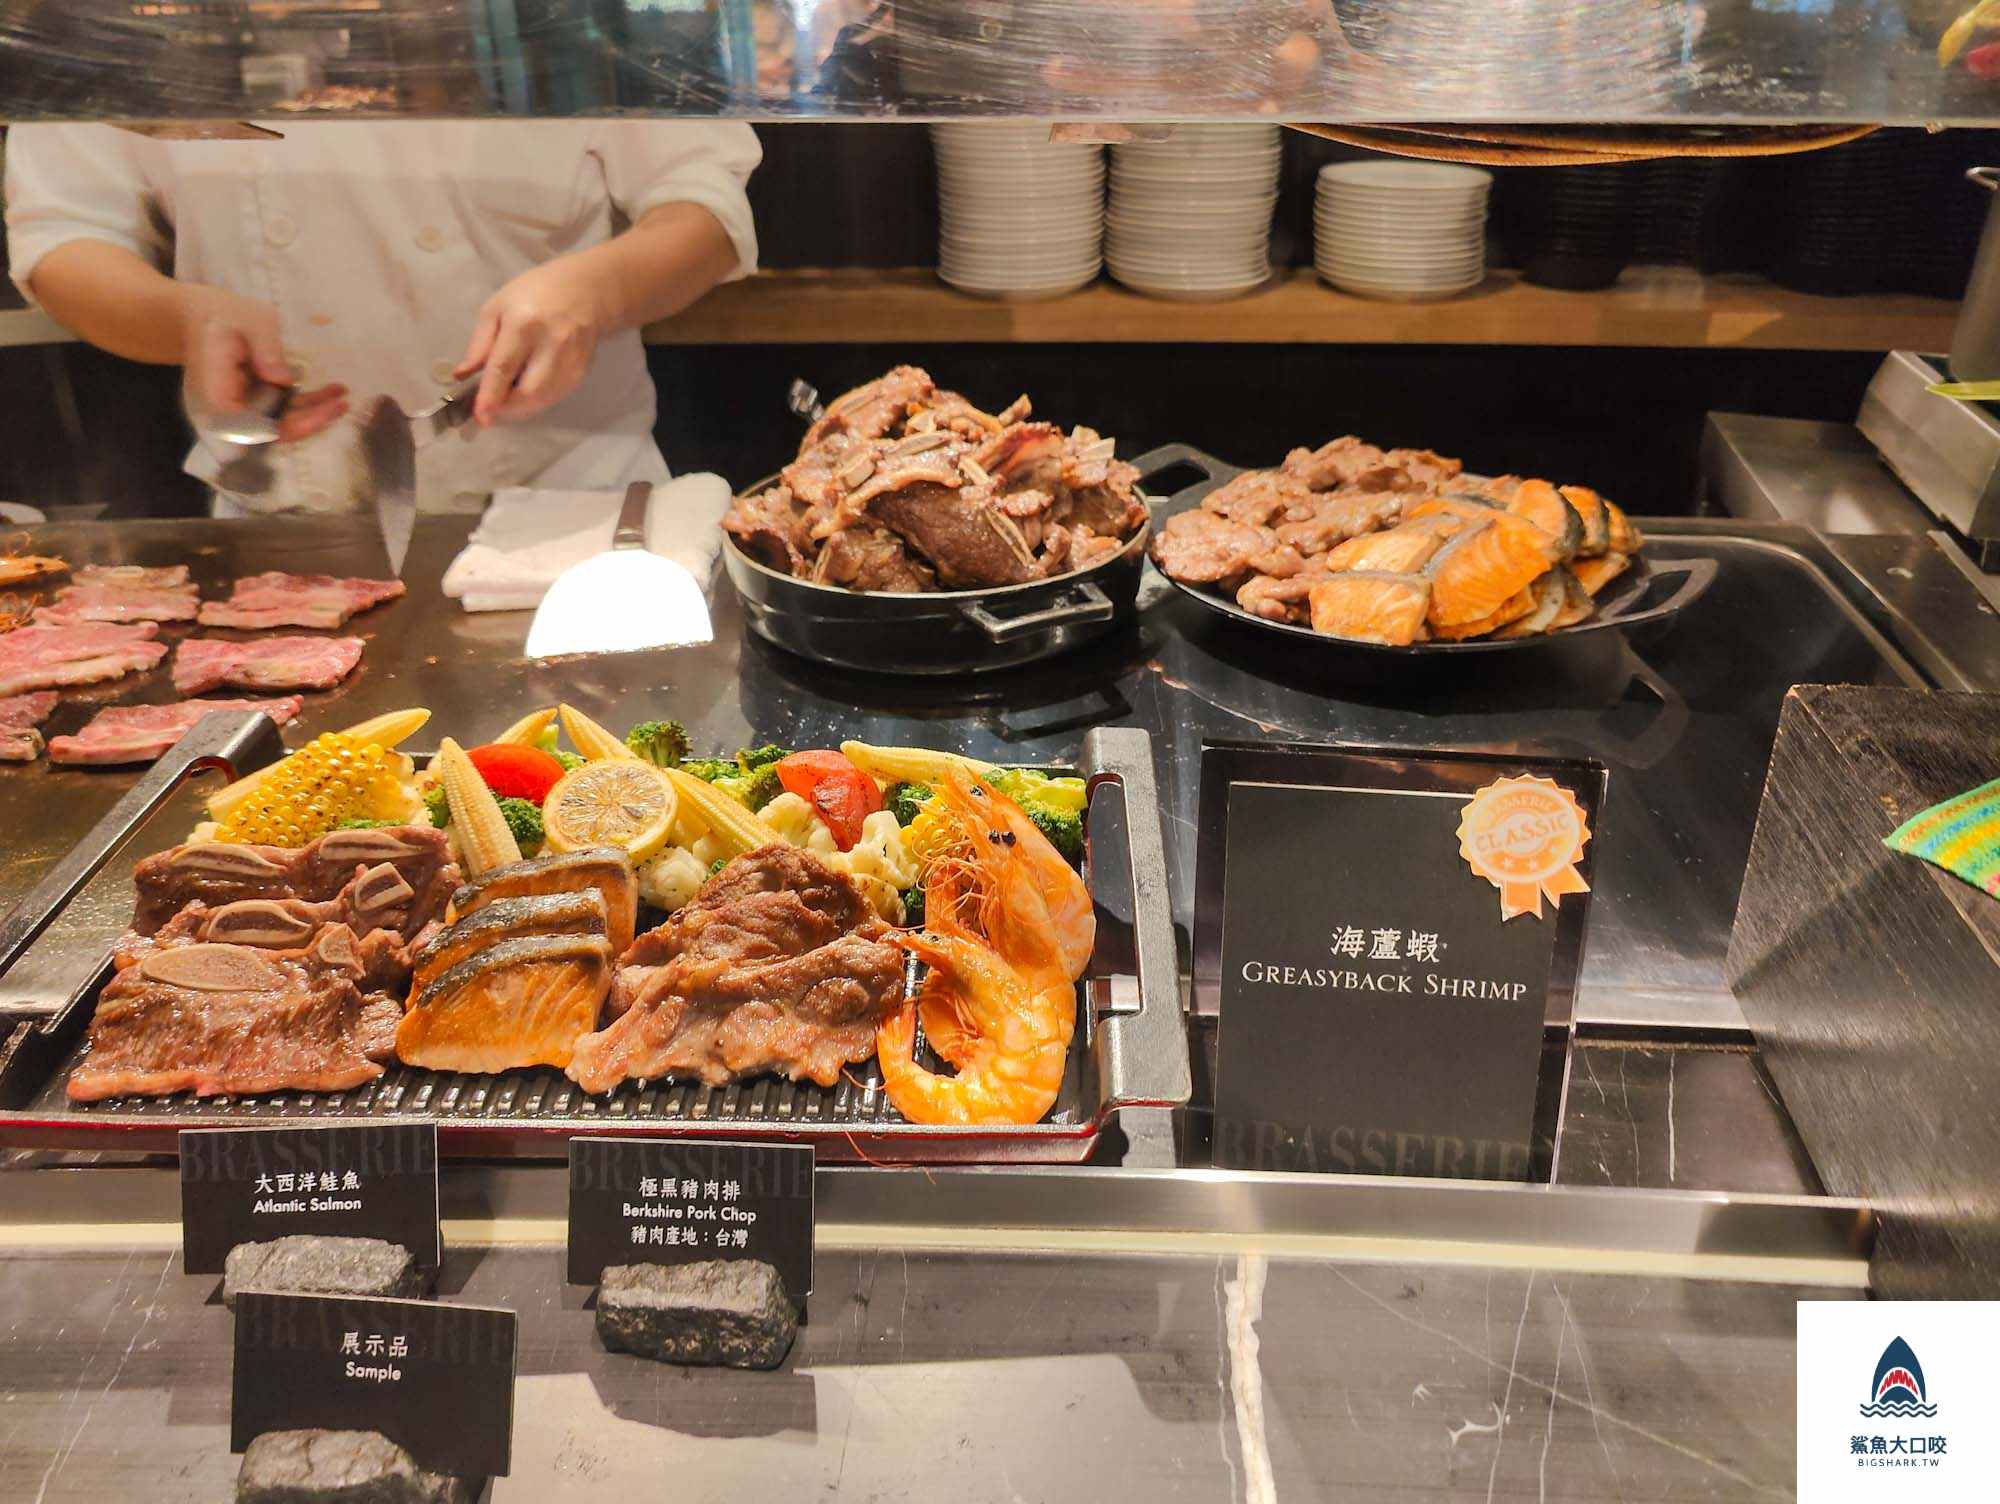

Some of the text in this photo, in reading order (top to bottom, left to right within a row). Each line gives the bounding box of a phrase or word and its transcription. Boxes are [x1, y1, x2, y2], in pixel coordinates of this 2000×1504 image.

[1475, 812, 1570, 852] CLASSIC
[1330, 925, 1440, 963] 海蘆蝦
[1242, 962, 1528, 1001] GREASYBACK SHRIMP
[254, 1170, 362, 1194] 大西洋鮭魚
[638, 1177, 741, 1202] 極黑豬肉排
[253, 1197, 362, 1214] Atlantic Salmon
[623, 1203, 757, 1225] Berkshire Pork Chop
[340, 1332, 409, 1357] 展示品
[345, 1362, 402, 1382] Sample
